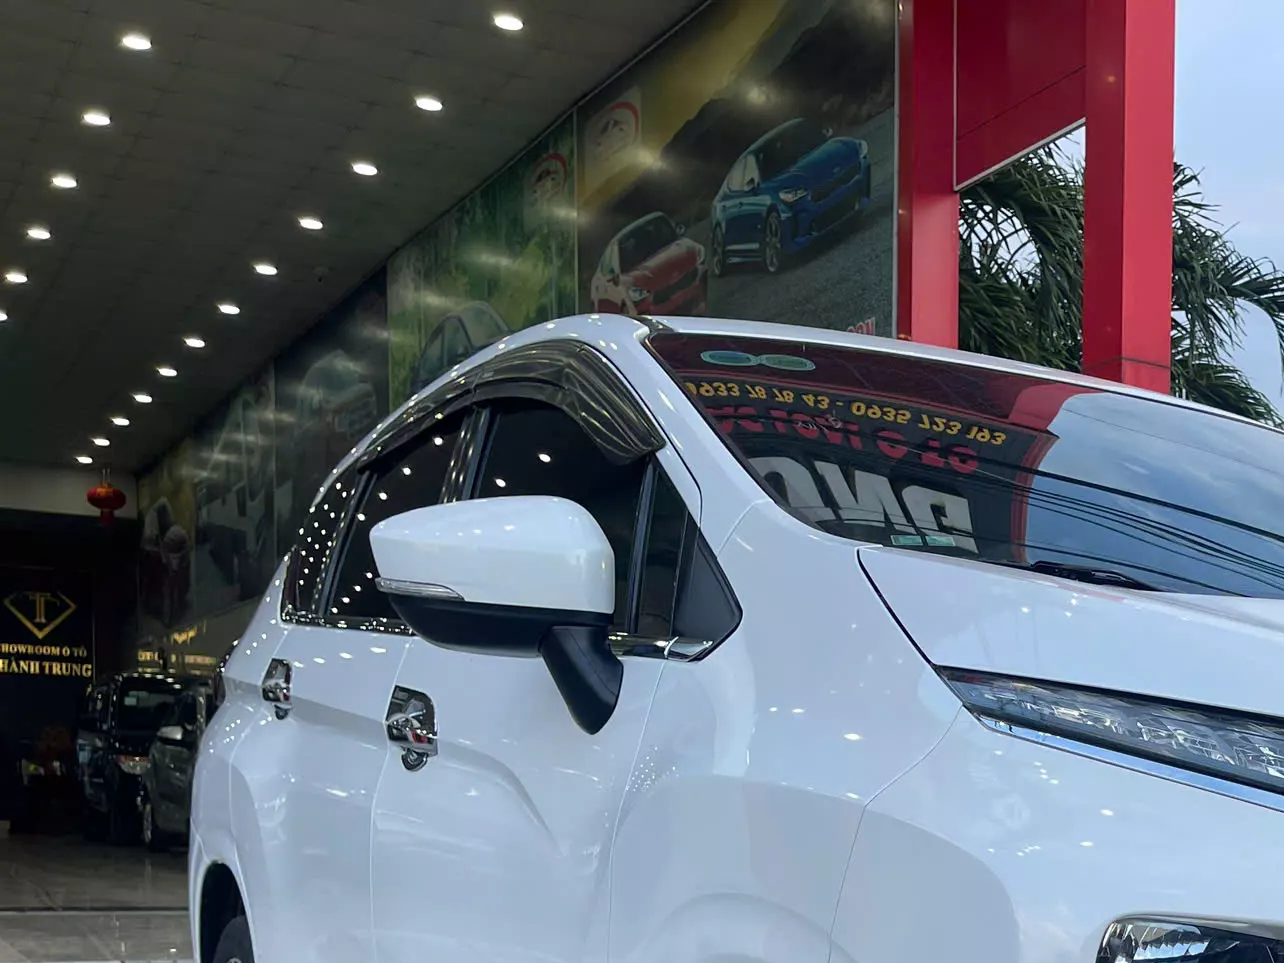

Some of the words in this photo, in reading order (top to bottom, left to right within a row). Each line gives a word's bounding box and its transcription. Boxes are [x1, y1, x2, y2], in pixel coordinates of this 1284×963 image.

[0, 643, 60, 656] HOWROOM
[0, 656, 40, 675] HÀNH
[42, 661, 92, 677] TRUNG
